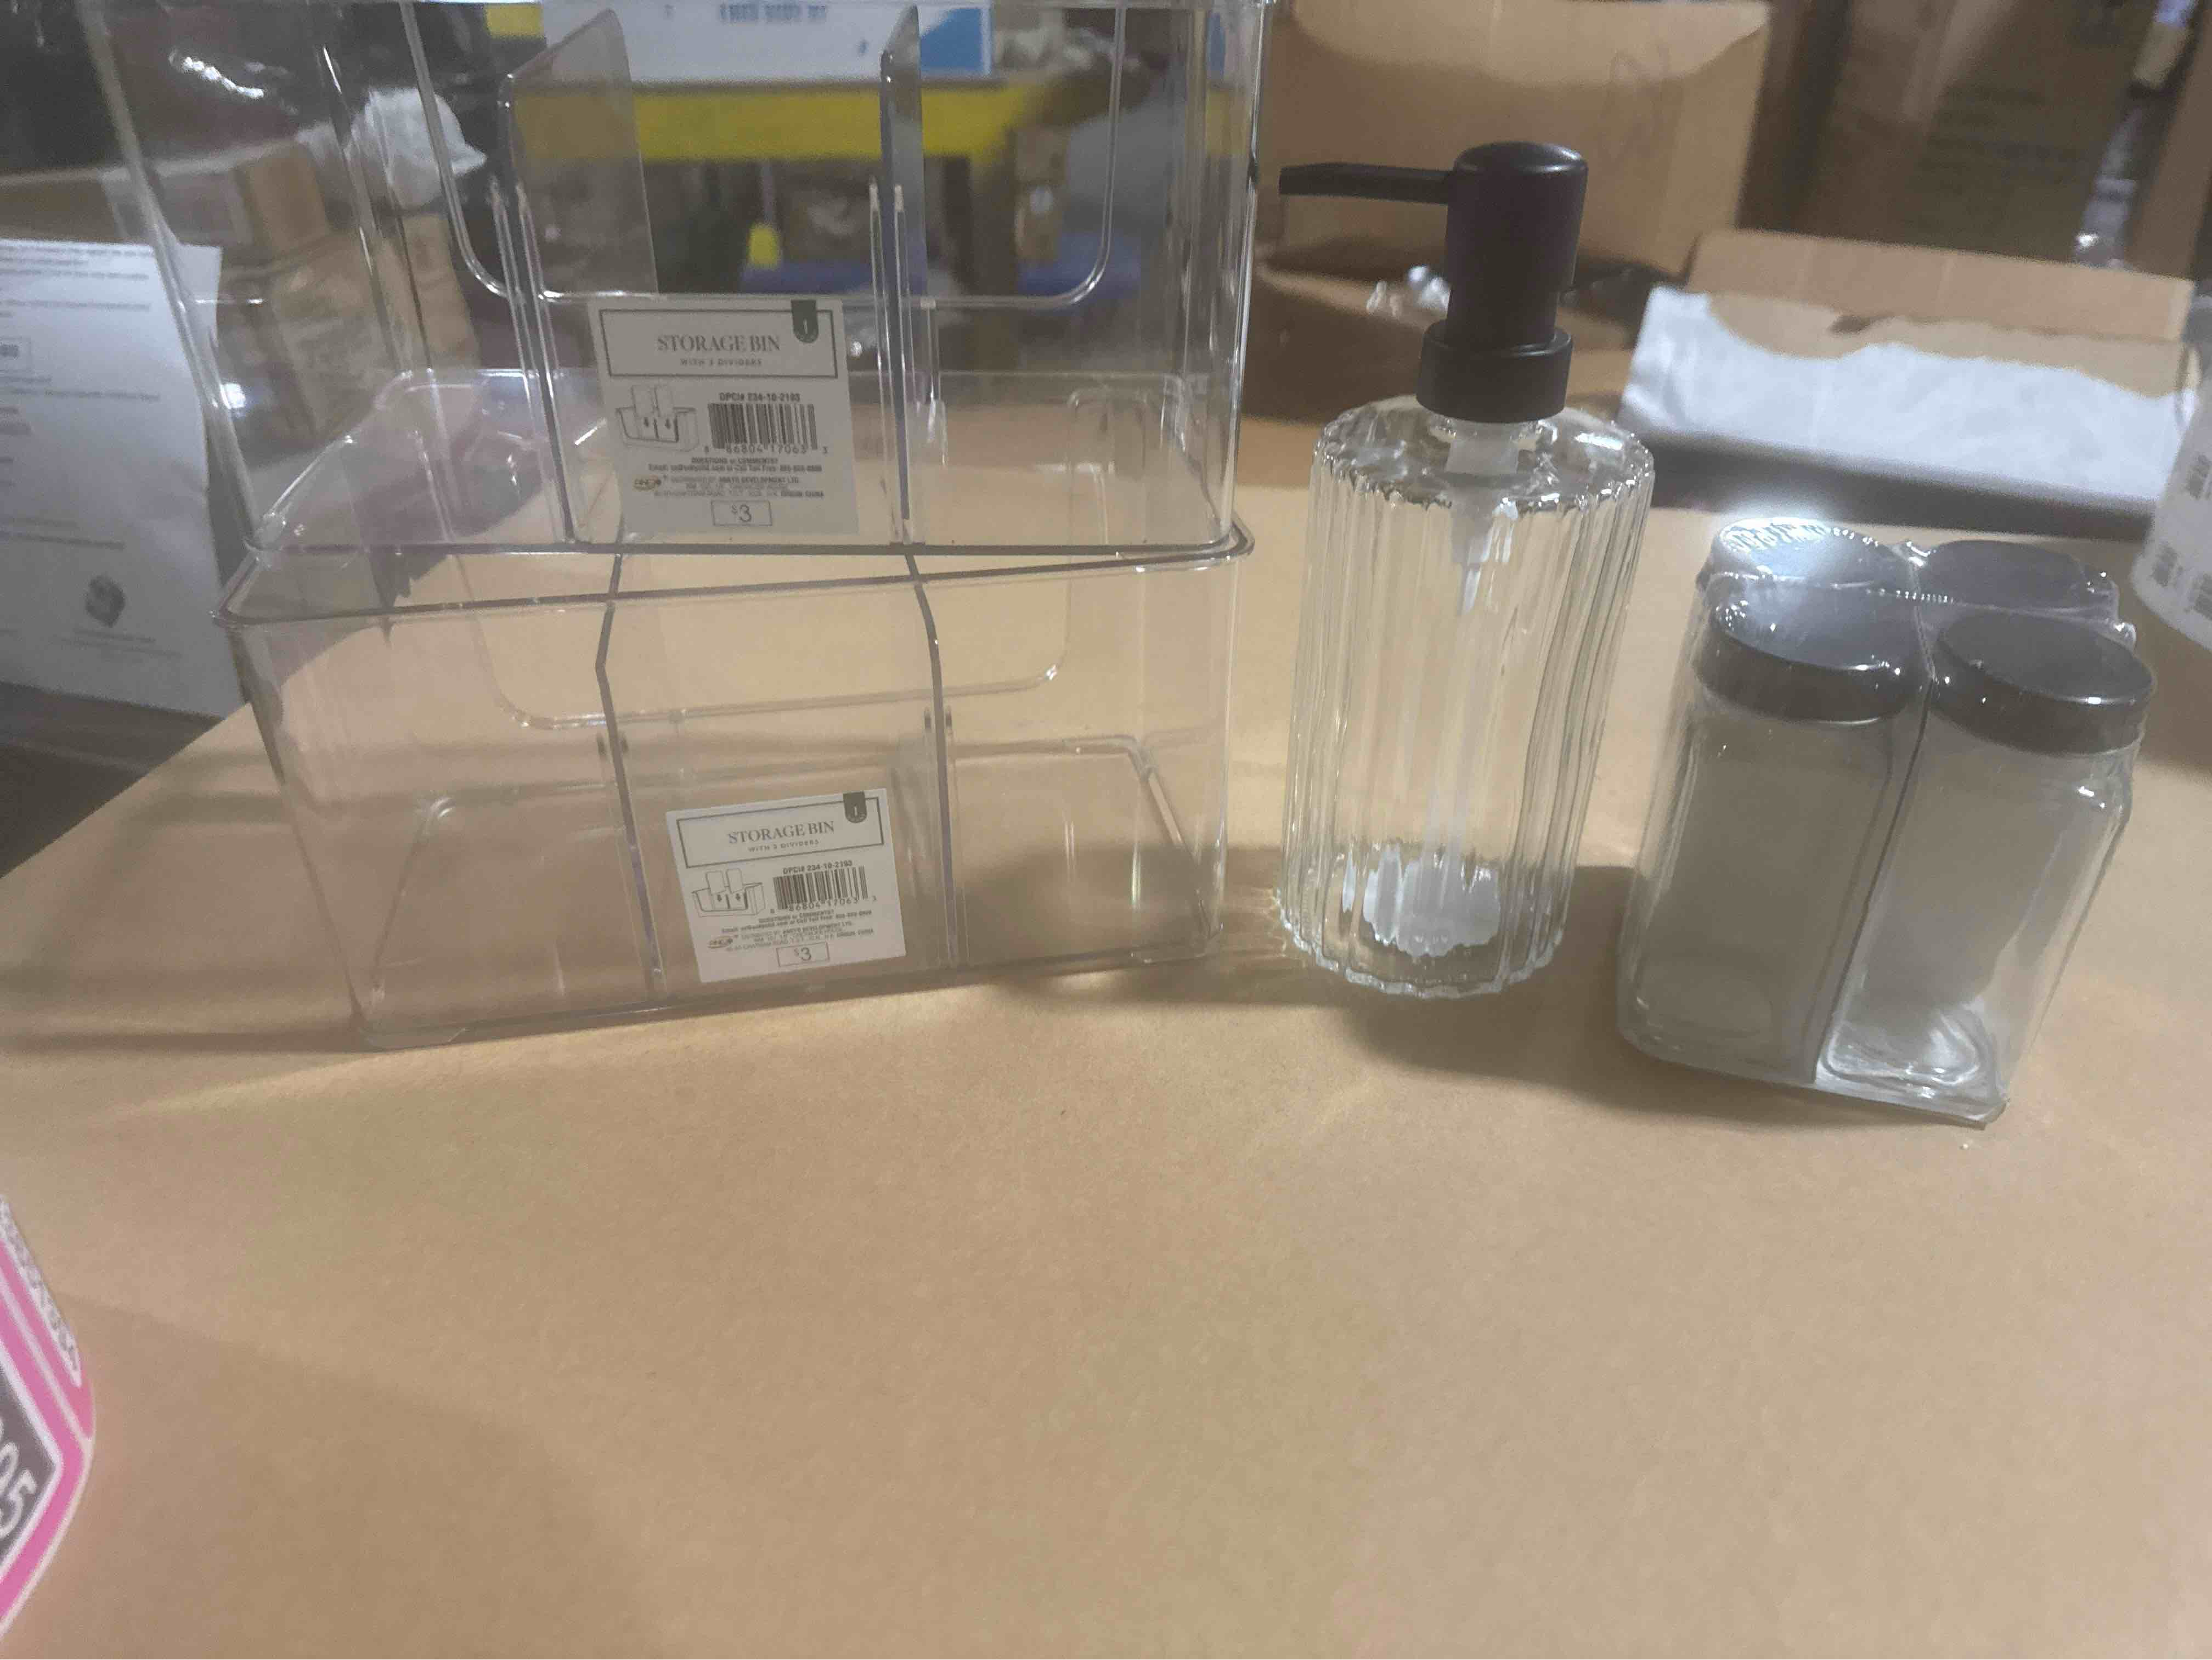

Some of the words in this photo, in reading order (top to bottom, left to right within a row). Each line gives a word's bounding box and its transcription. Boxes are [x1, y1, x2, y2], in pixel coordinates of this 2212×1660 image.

[657, 334, 747, 352] STORAGE
[750, 334, 781, 352] BIN
[731, 504, 752, 522] $3
[728, 824, 805, 843] STORAGE
[808, 820, 834, 835] BIN
[781, 840, 819, 849] DIVIDERS
[807, 860, 853, 871] 234-10-2193
[794, 947, 812, 961] $3
